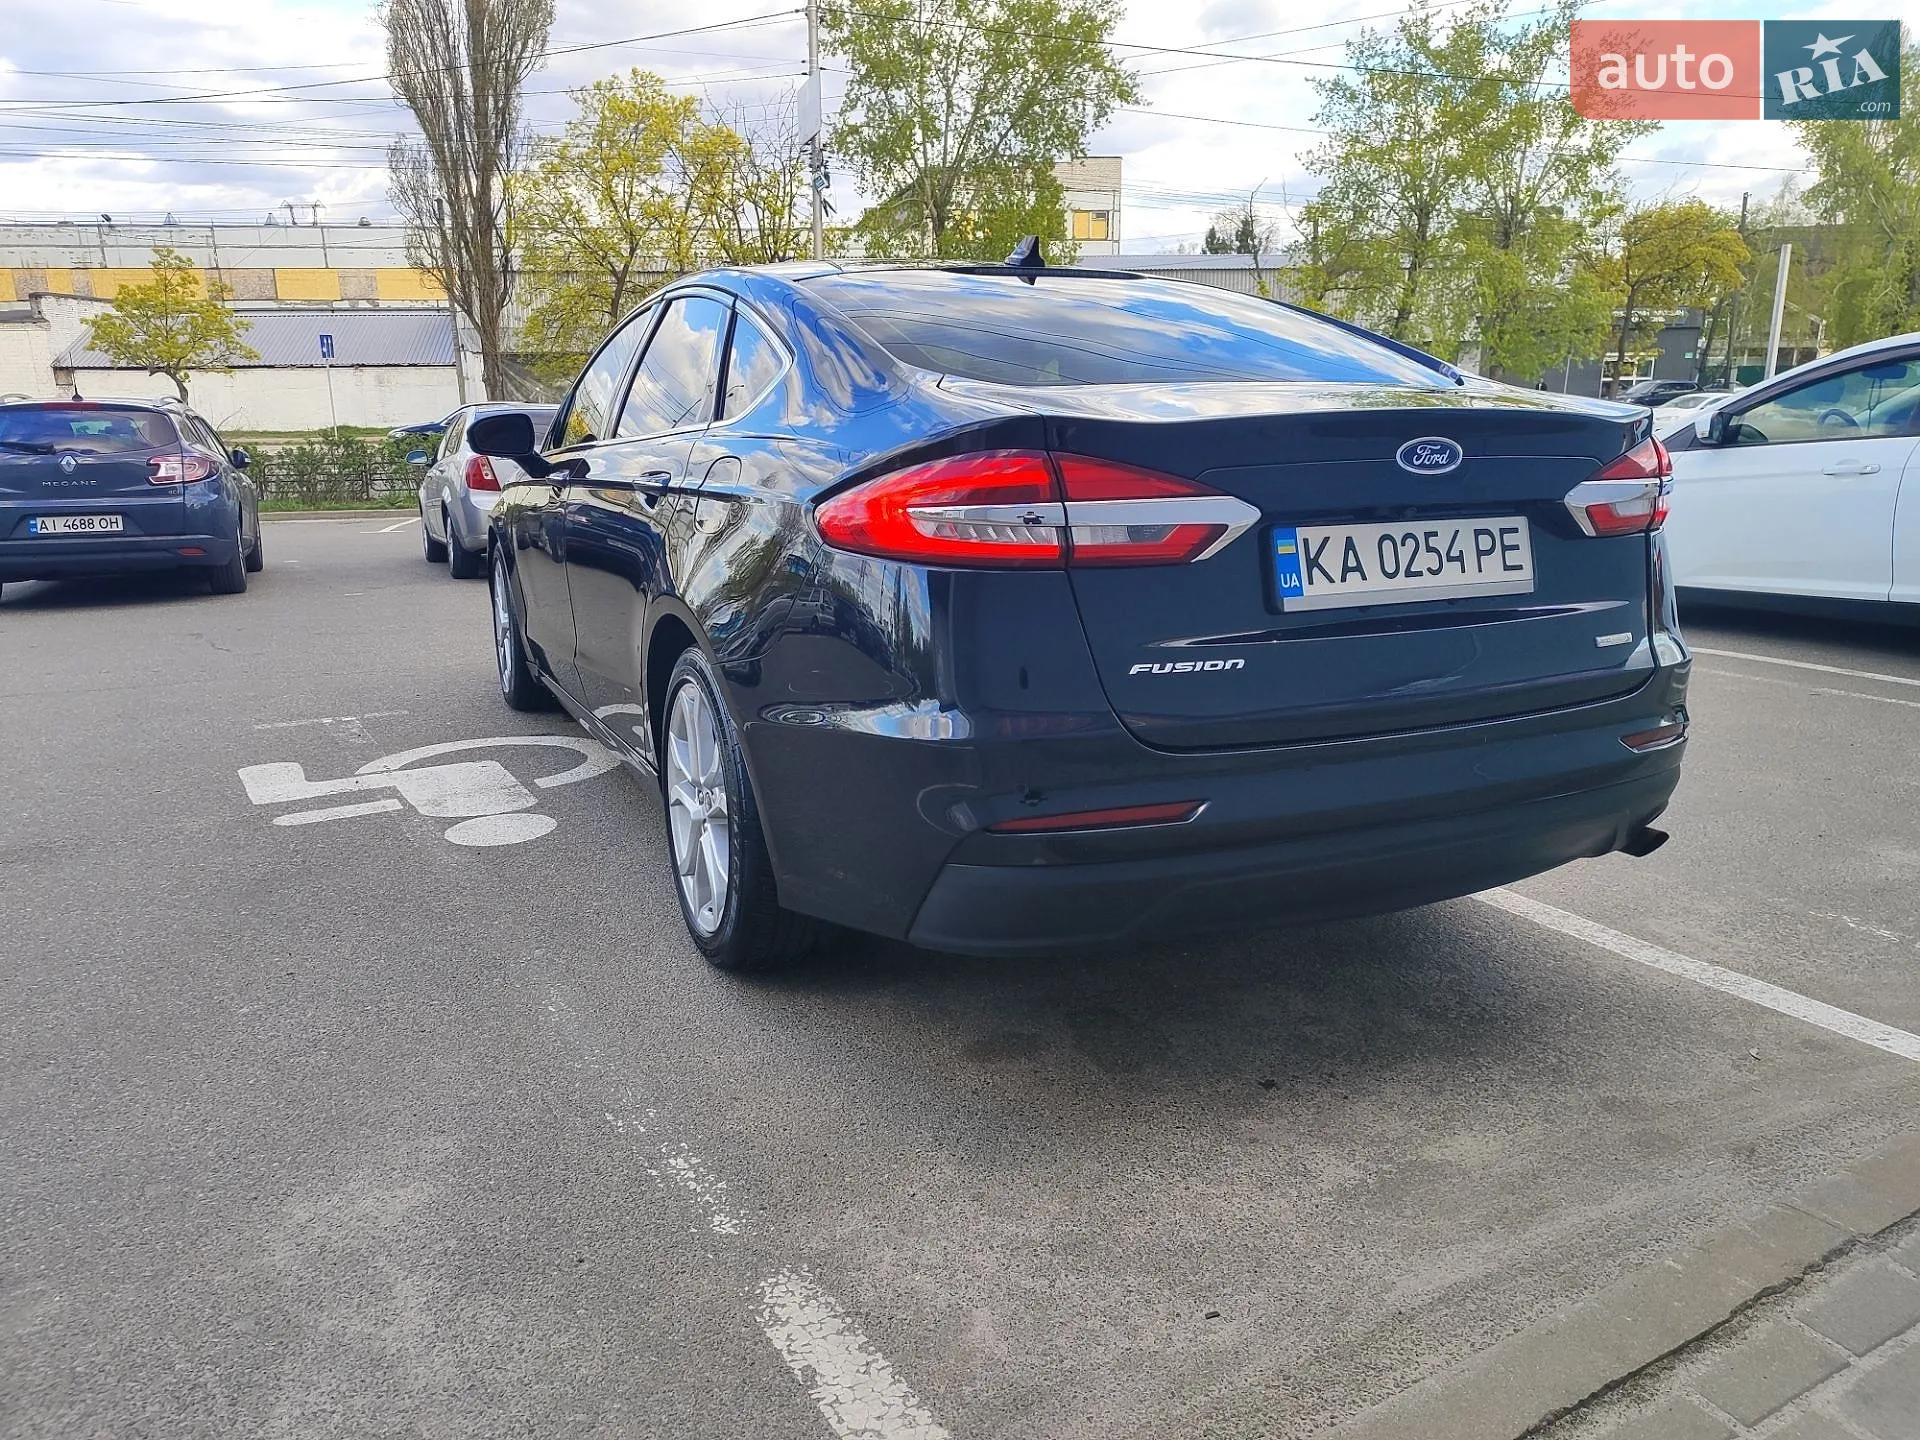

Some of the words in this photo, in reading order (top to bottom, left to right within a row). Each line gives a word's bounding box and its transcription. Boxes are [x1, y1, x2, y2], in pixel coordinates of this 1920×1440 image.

[1413, 444, 1450, 466] Ford
[40, 519, 57, 531] AI
[63, 518, 95, 531] 4688
[98, 517, 120, 530] OH
[1303, 536, 1368, 585] KA
[1377, 529, 1467, 580] 0254
[1473, 527, 1524, 573] PE
[1280, 573, 1300, 589] UA
[1128, 659, 1245, 675] FUSION
